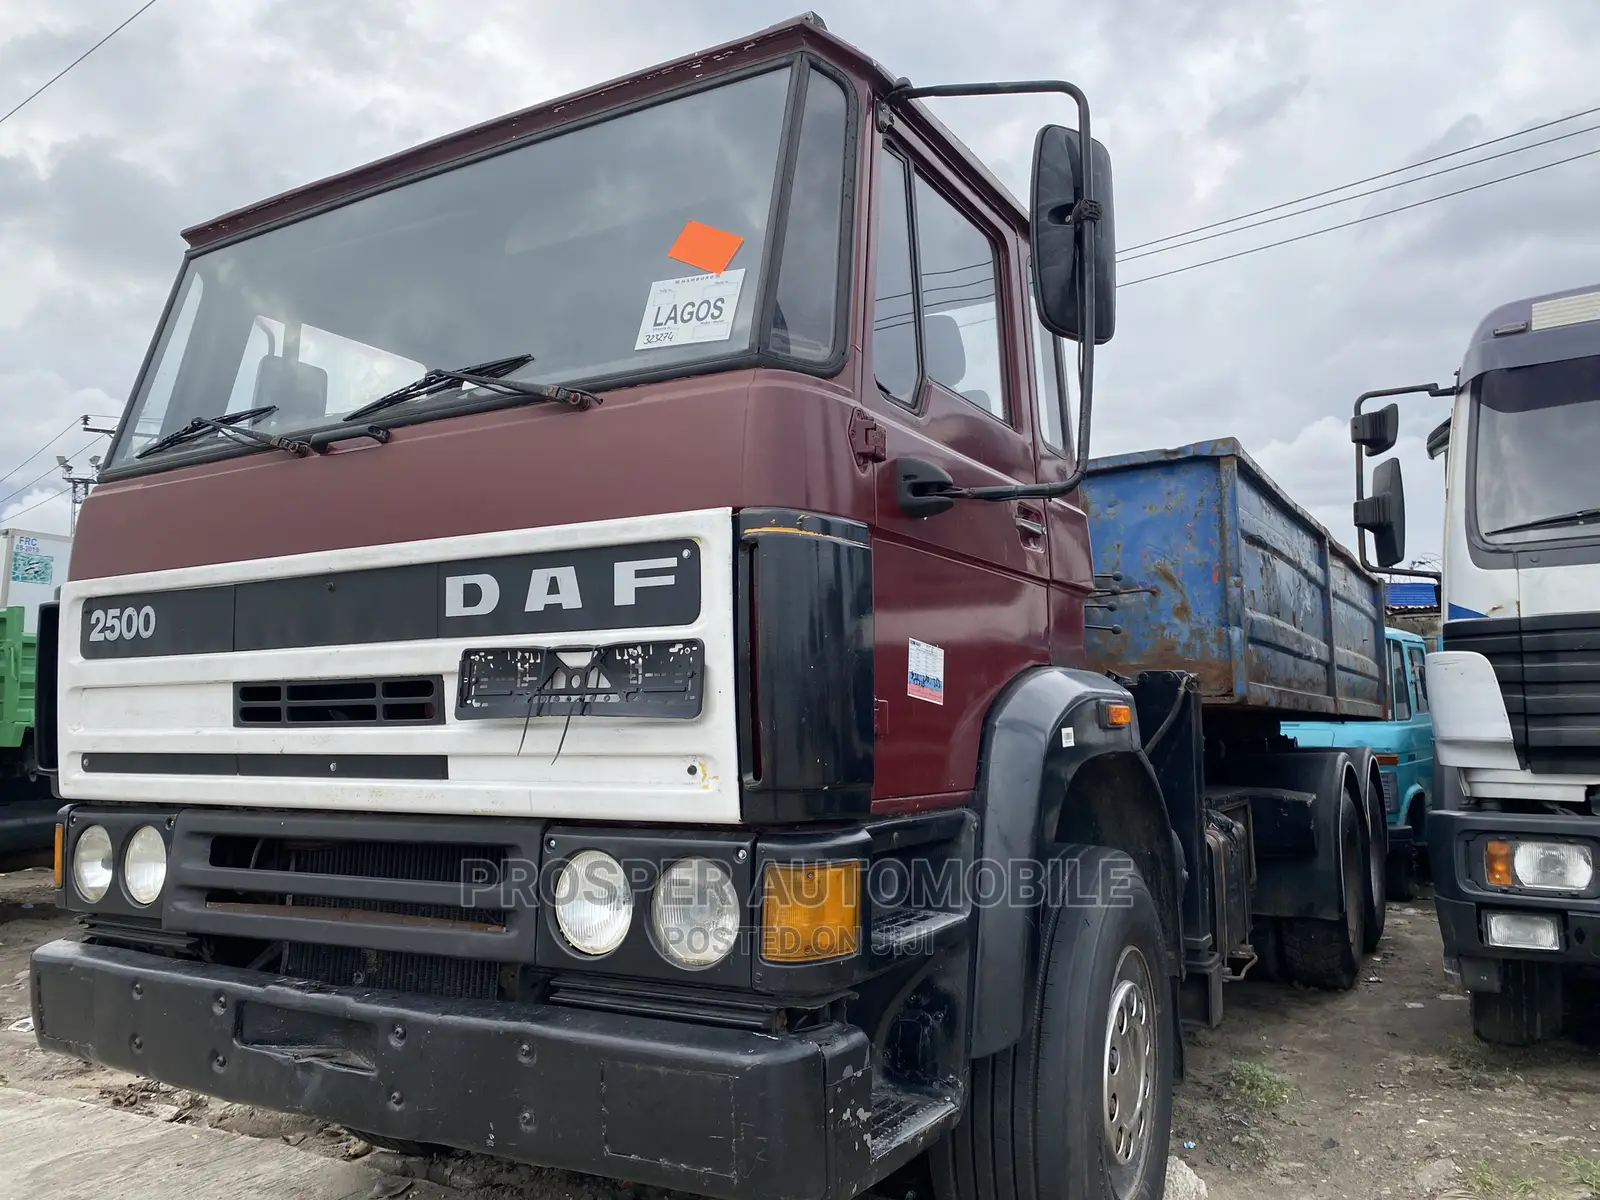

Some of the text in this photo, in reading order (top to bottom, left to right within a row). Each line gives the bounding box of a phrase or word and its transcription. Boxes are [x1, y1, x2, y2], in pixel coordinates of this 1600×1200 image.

[653, 297, 725, 327] LAGOS
[643, 331, 674, 345] 323274
[19, 536, 37, 546] FRC
[445, 557, 678, 617] DAF
[89, 605, 156, 642] 2500
